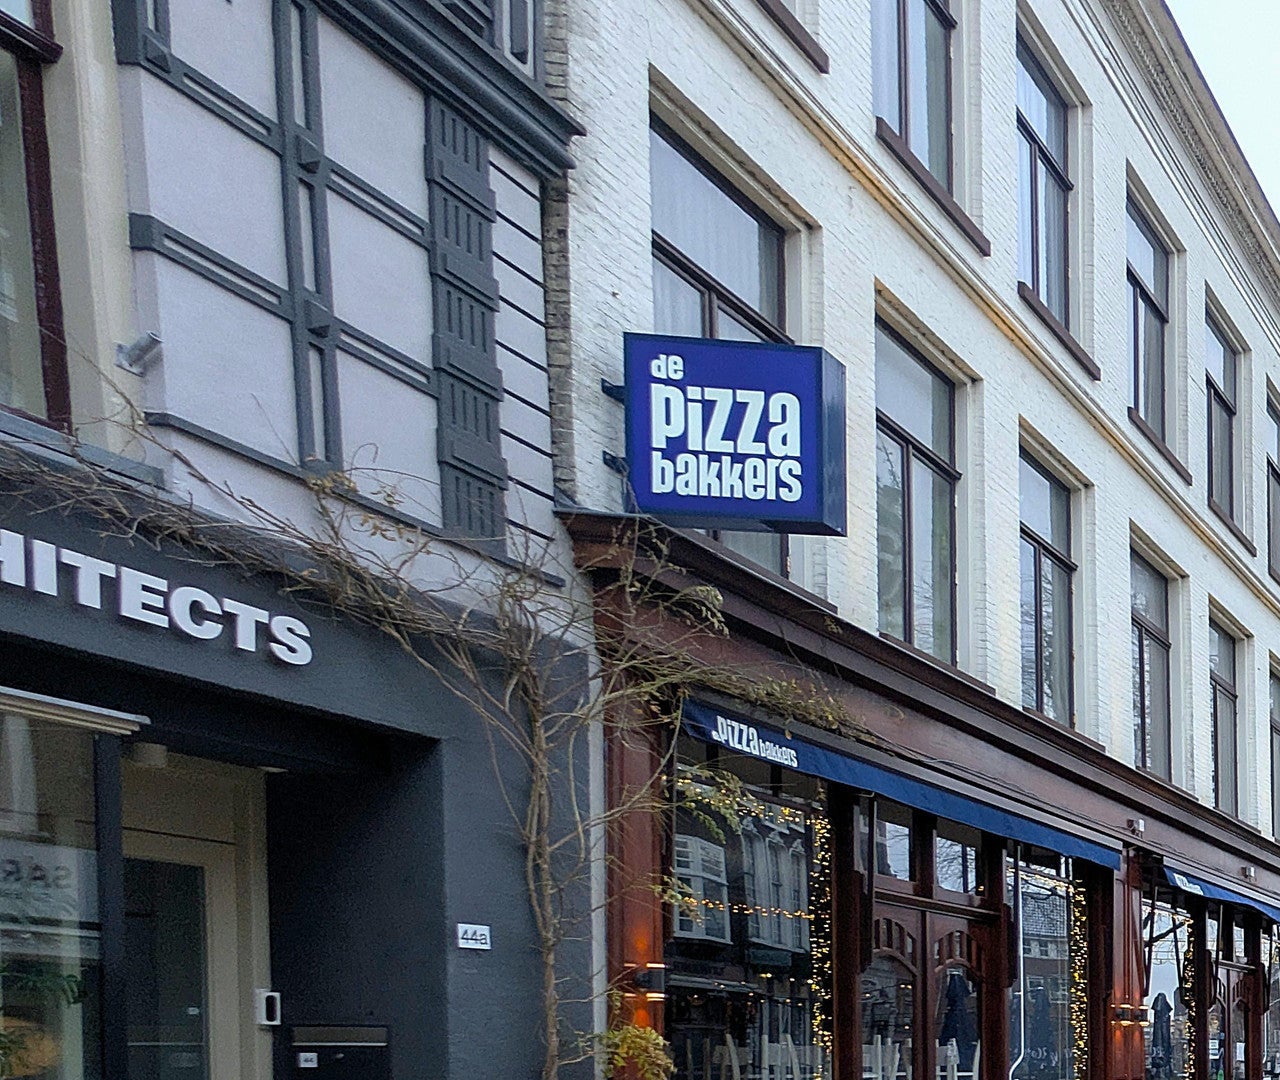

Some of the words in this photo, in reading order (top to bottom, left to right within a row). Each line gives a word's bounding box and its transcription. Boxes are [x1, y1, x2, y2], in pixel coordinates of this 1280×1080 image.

[650, 354, 684, 380] de
[651, 450, 803, 502] bakkers
[461, 929, 488, 945] 44a
